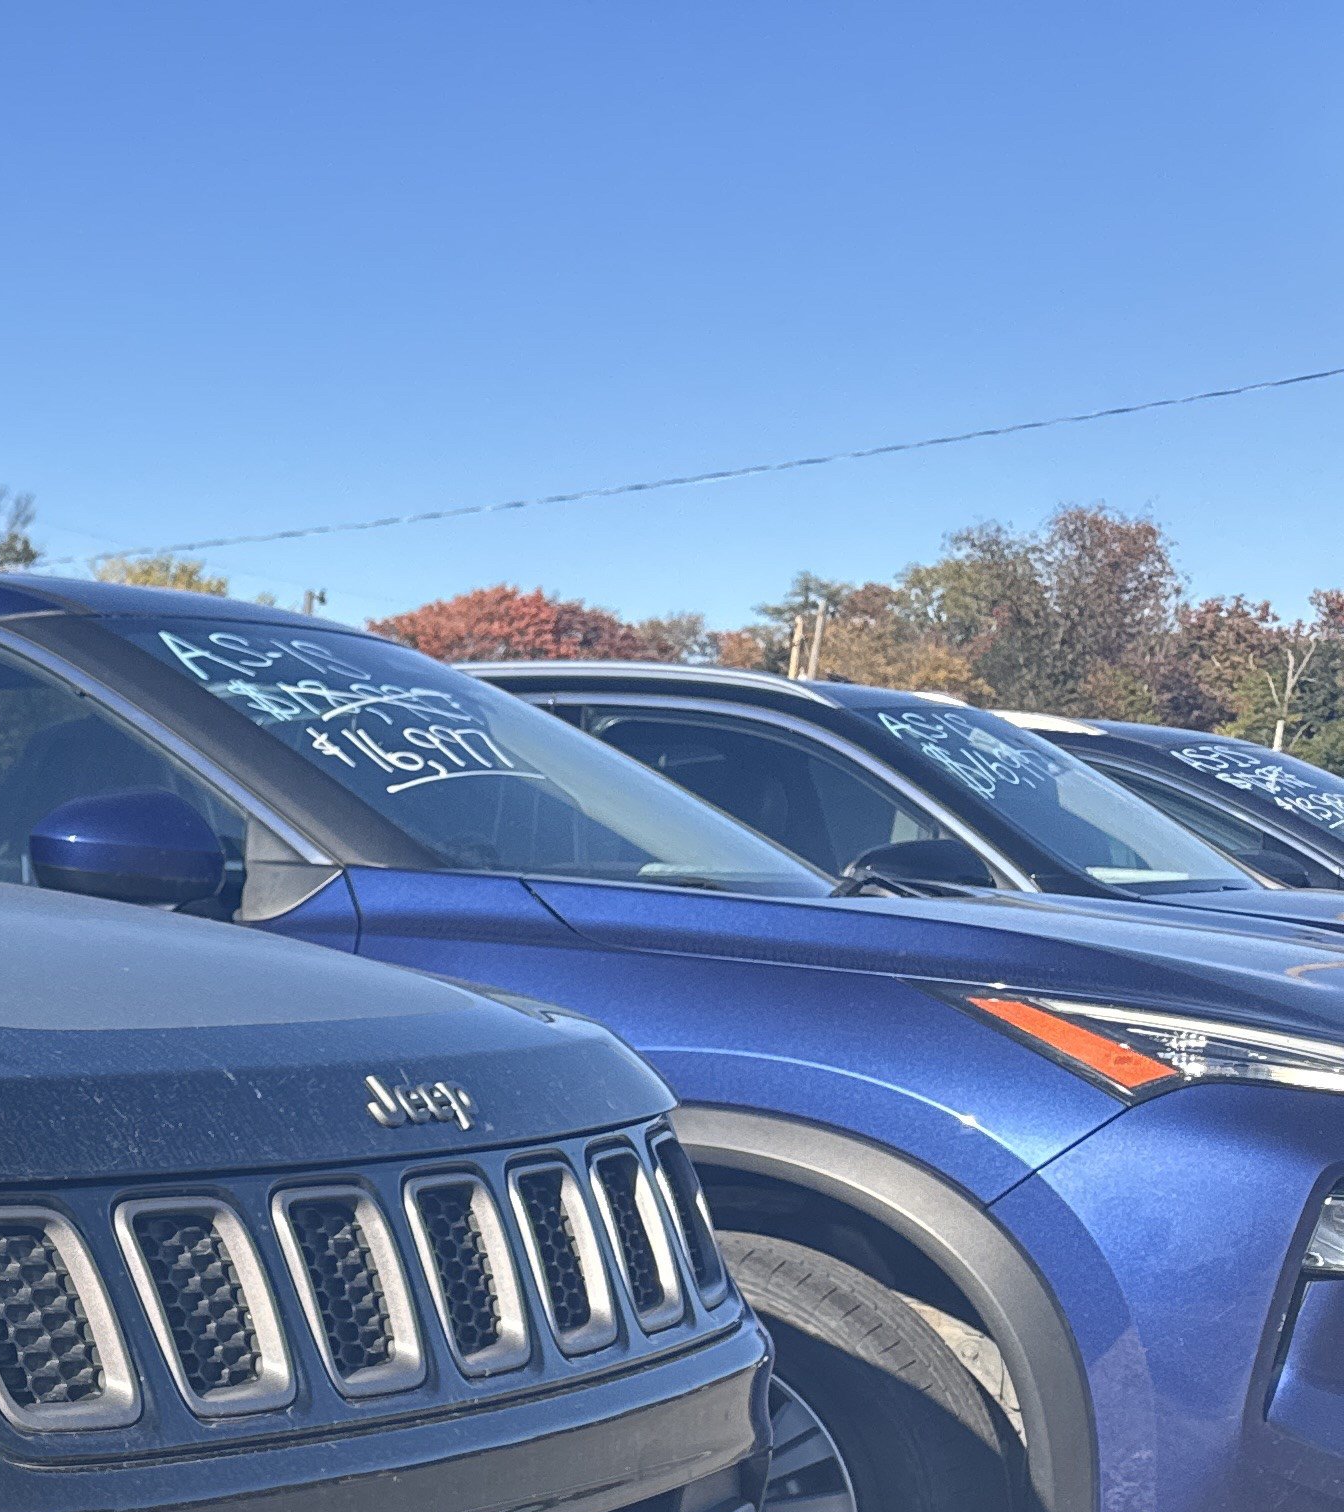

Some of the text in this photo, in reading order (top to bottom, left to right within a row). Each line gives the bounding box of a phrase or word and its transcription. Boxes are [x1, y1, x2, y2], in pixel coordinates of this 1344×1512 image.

[158, 630, 372, 681] AS-IS
[305, 724, 515, 780] $16,997
[365, 1075, 480, 1131] Jeep
